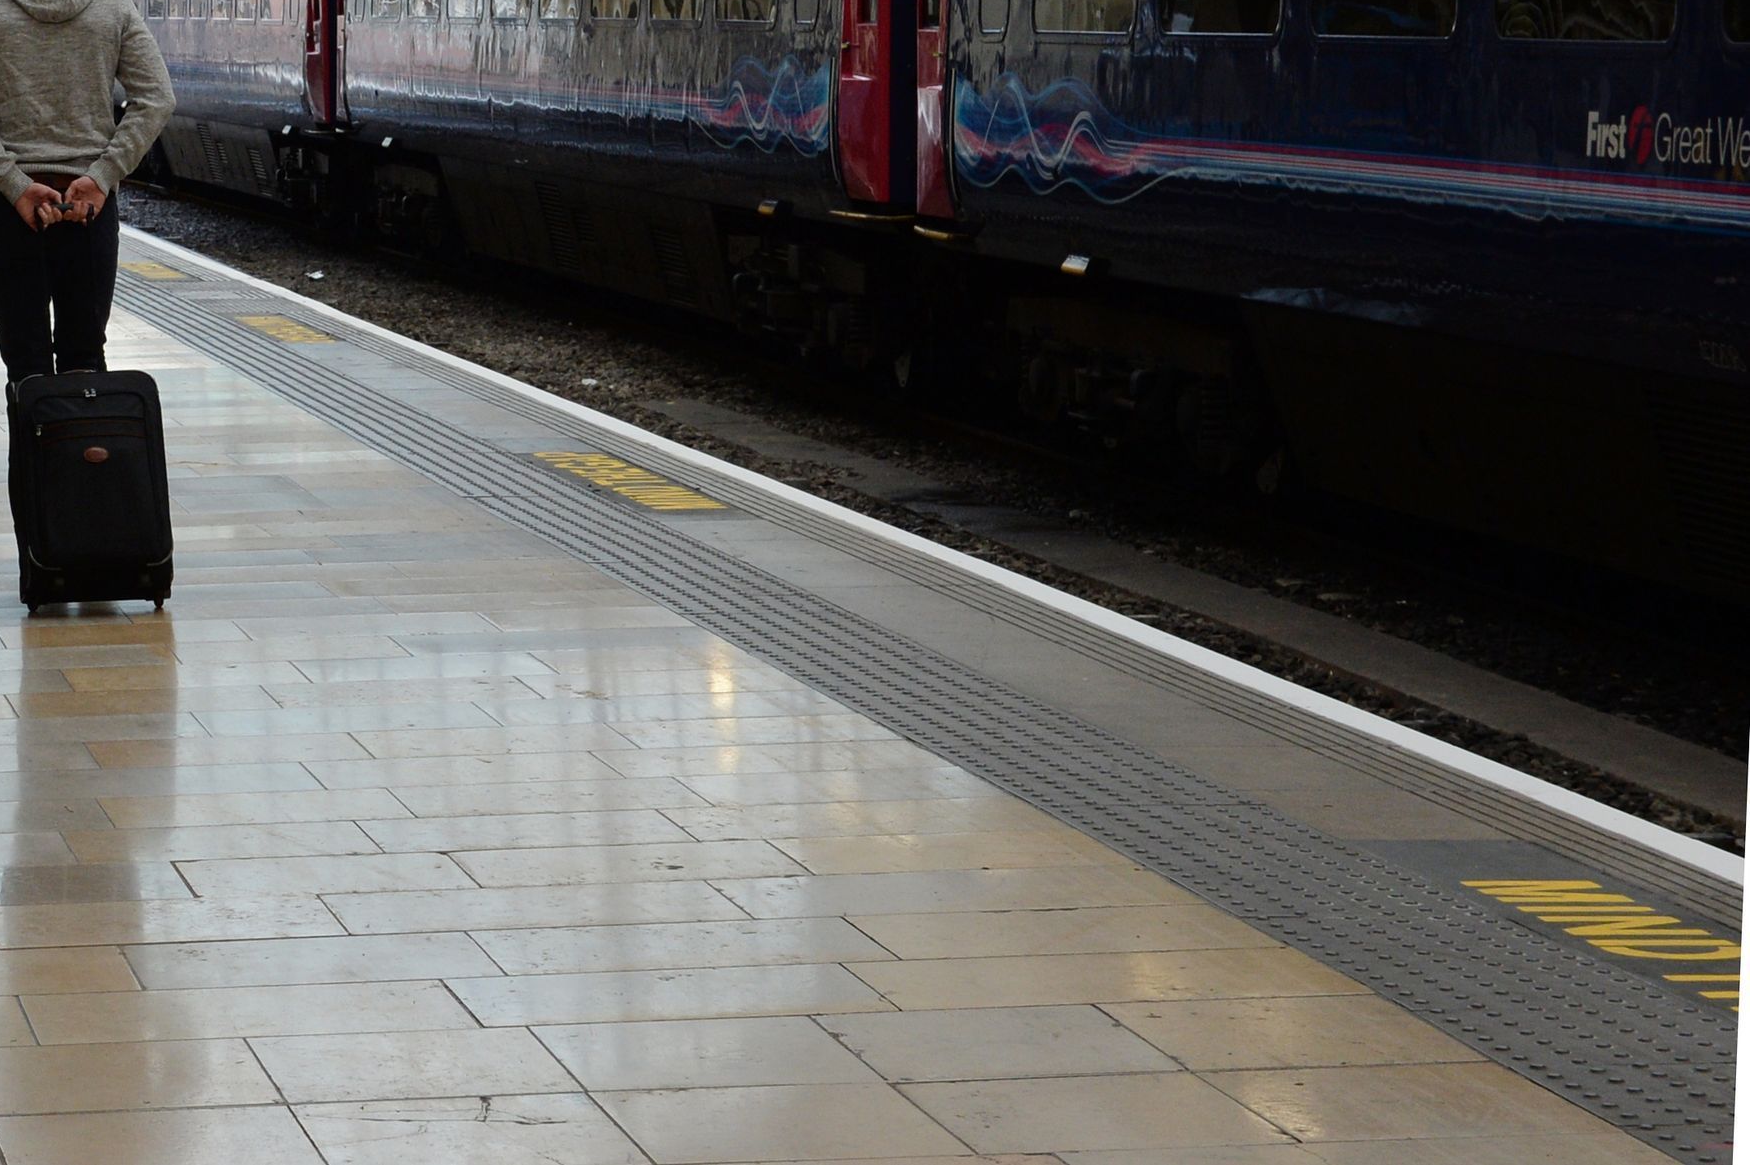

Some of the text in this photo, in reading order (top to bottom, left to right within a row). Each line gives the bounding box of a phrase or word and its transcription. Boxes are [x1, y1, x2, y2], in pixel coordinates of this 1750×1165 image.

[1586, 111, 1627, 159] First
[1654, 112, 1712, 165] Great
[533, 451, 627, 468] GAP
[569, 467, 668, 486] THE
[612, 485, 729, 510] MIND
[1460, 880, 1741, 960] MIND
